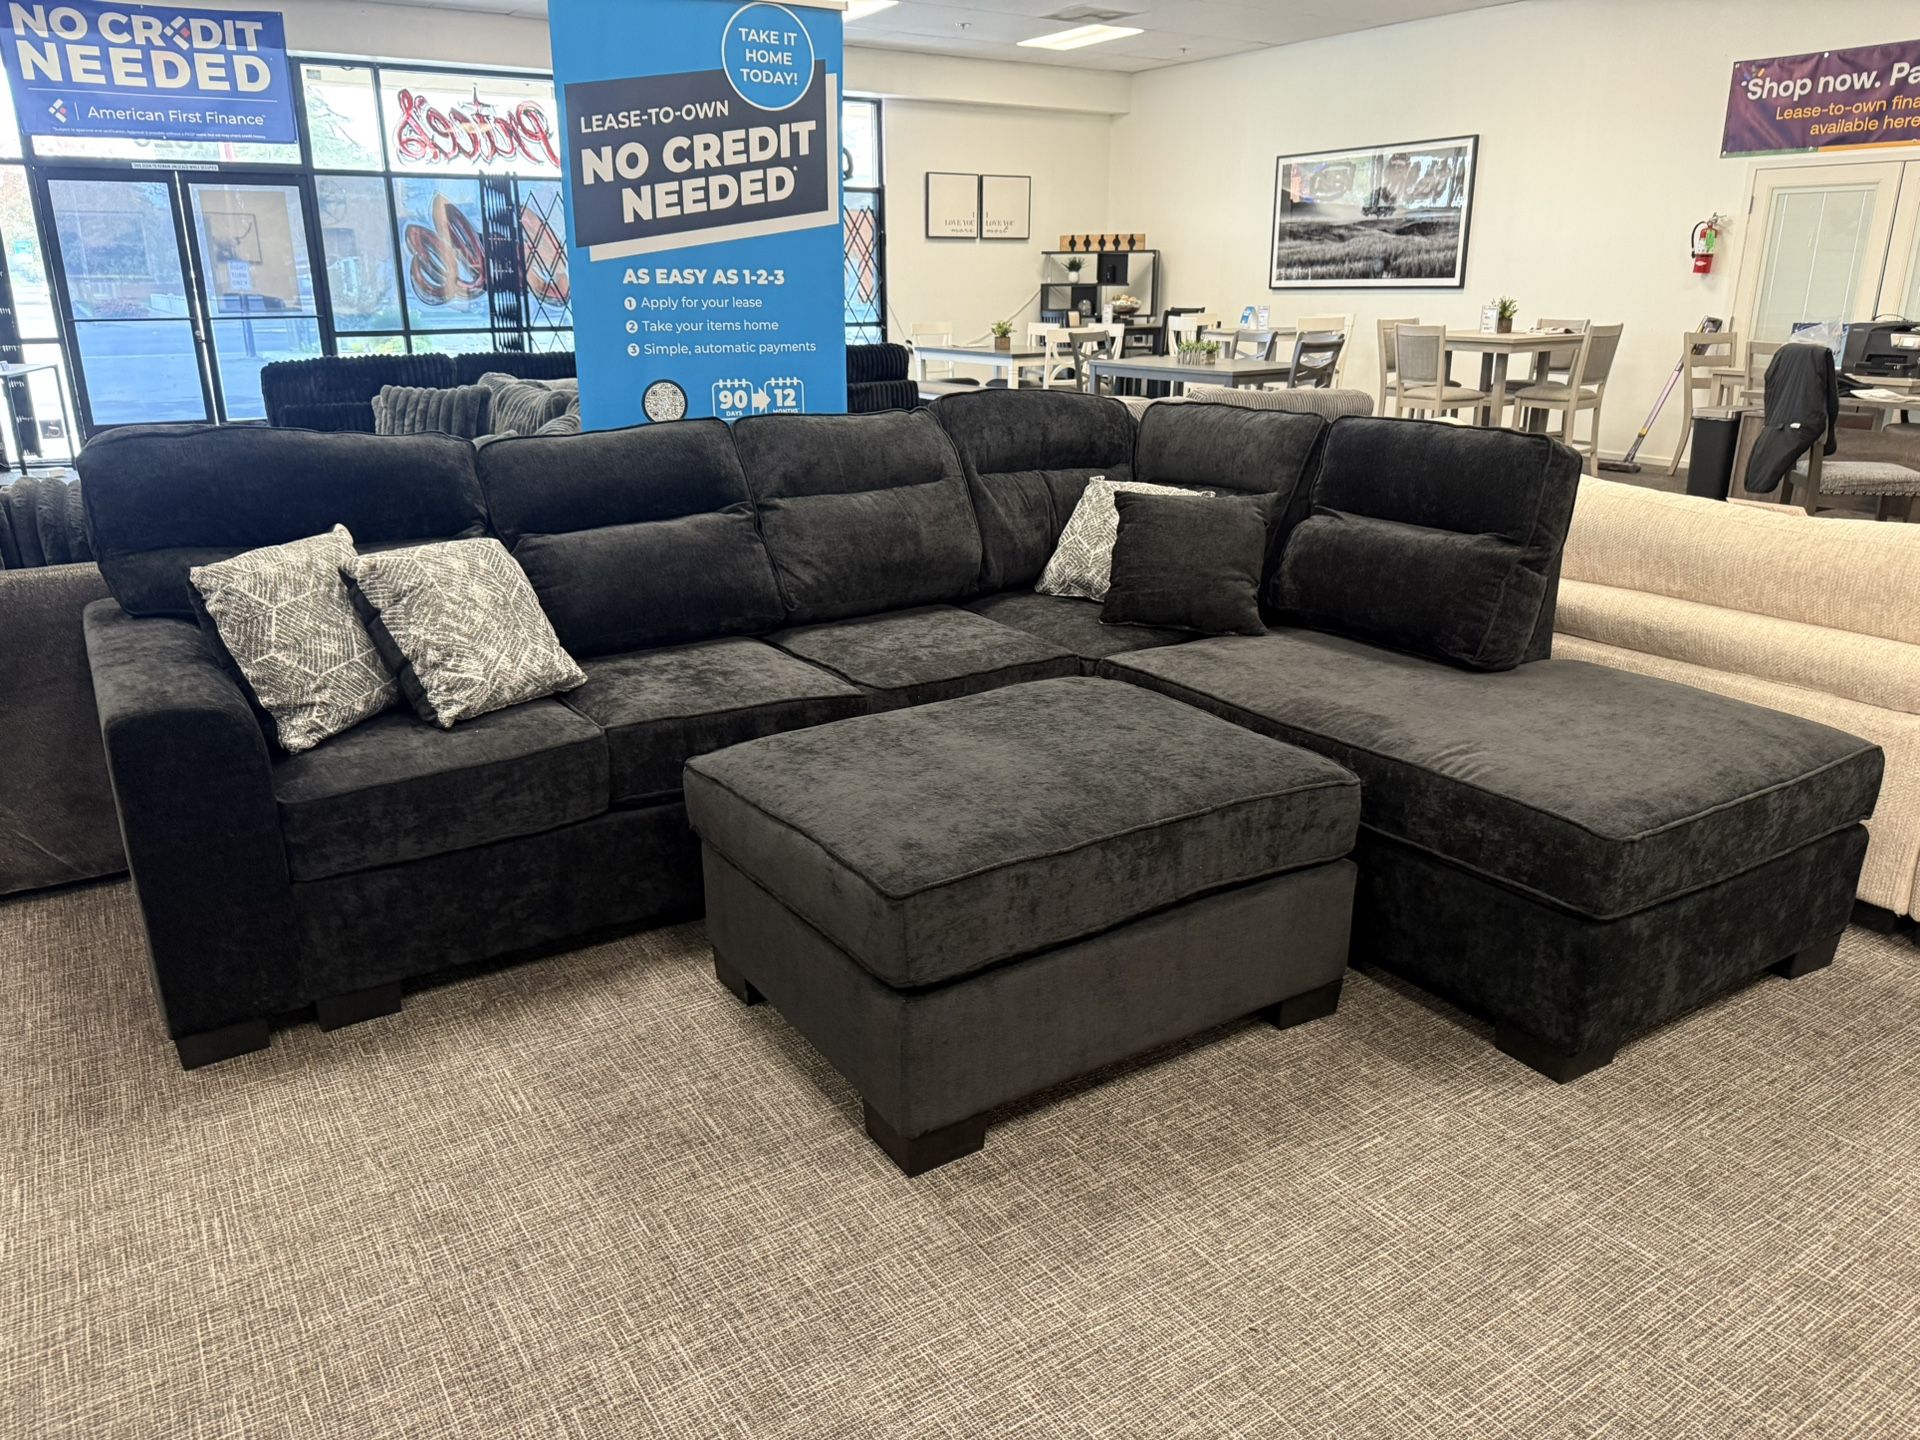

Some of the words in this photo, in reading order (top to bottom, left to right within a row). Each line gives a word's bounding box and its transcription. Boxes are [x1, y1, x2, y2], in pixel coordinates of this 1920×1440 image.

[9, 2, 88, 40] NO
[98, 11, 263, 51] CRDIT
[738, 27, 779, 45] TAKE
[783, 32, 797, 46] IT
[16, 40, 271, 92] NEEDED
[745, 49, 792, 65] HOME
[740, 68, 798, 86] TODAY!
[1747, 76, 1812, 101] Shop
[1817, 70, 1881, 94] now.
[1889, 61, 1920, 86] Pa
[87, 105, 165, 121] American
[168, 109, 202, 124] First
[205, 111, 265, 126] Finance
[580, 100, 729, 133] LEASE-TO-OWN
[1776, 99, 1887, 121] Lease-to-own
[1810, 117, 1878, 135] available
[1883, 115, 1920, 130] here
[581, 142, 649, 185] NO
[662, 120, 816, 173] CREDIT
[622, 268, 650, 285] AS
[655, 268, 707, 284] EASY
[712, 268, 739, 285] AS
[743, 269, 785, 285] 1-2-3
[641, 297, 679, 310] Apply
[682, 296, 698, 308] for
[701, 299, 729, 311] your
[732, 296, 763, 308] lease
[642, 320, 673, 332] Take
[675, 322, 702, 334] your
[706, 319, 741, 332] items
[744, 319, 779, 331] home
[643, 343, 692, 357] Simple,
[694, 341, 756, 354] automatic
[759, 341, 817, 355] payments
[718, 389, 748, 410] 90
[773, 388, 797, 407] 12
